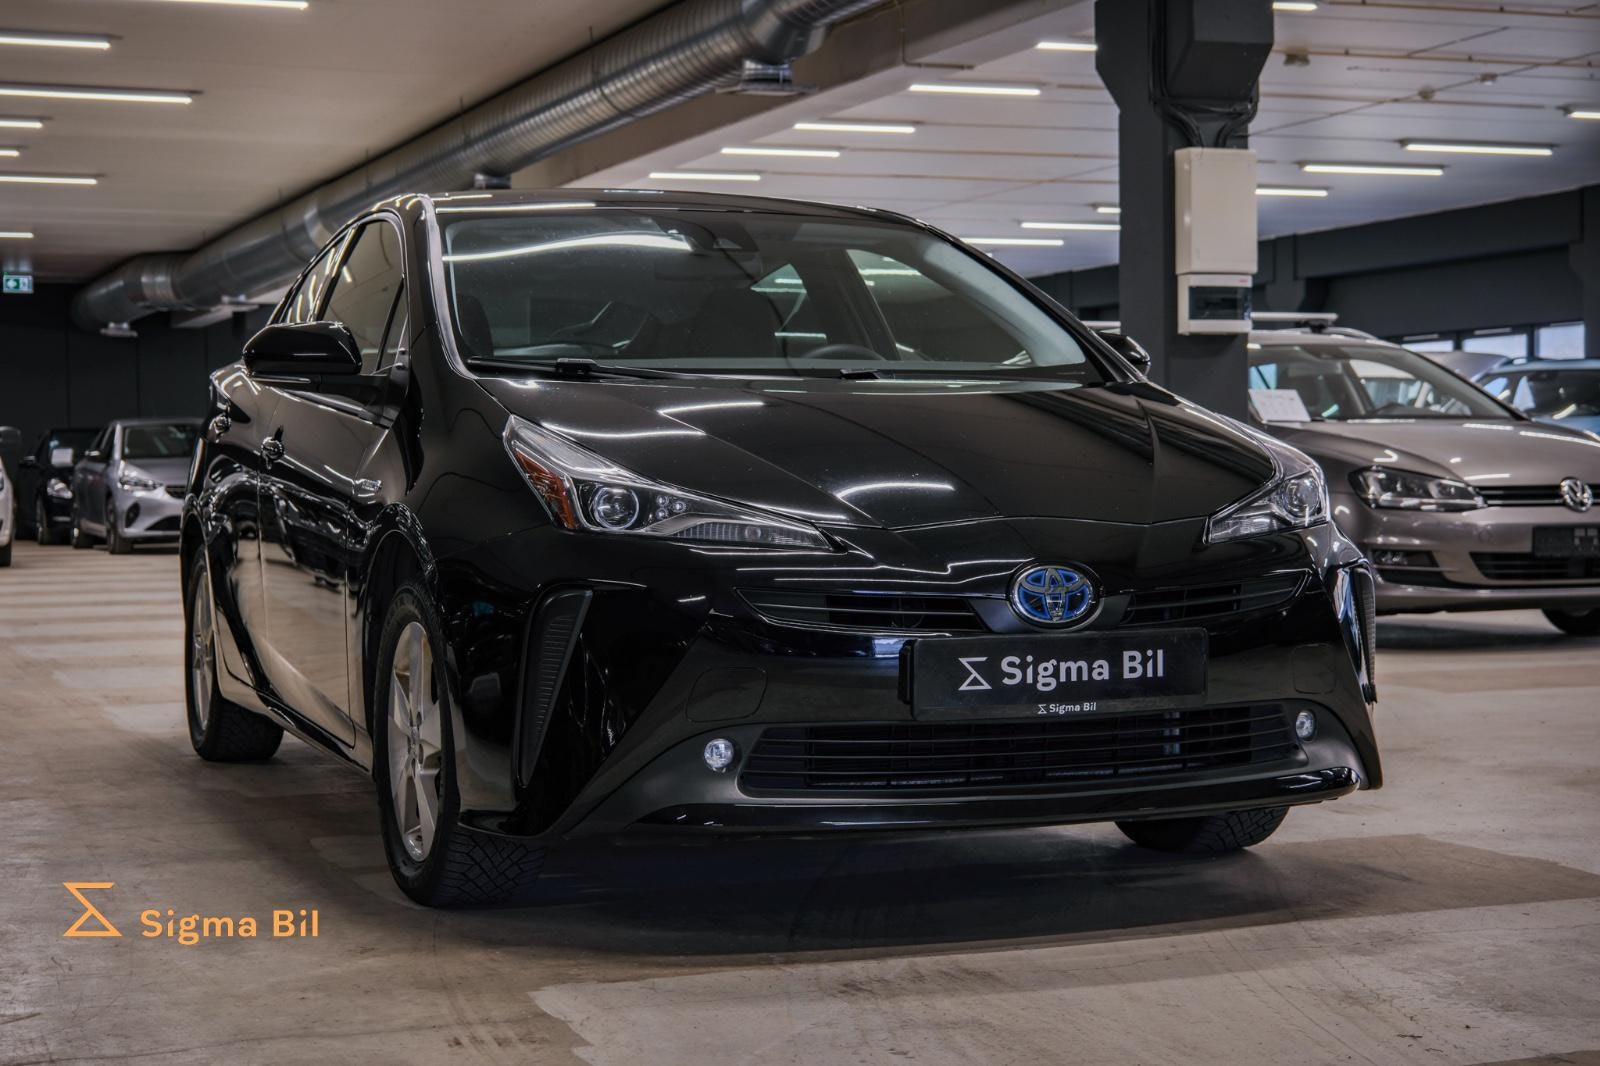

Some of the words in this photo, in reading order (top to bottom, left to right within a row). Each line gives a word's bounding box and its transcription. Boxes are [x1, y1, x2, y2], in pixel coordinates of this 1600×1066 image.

[1000, 655, 1110, 692] Sigma
[1122, 649, 1164, 679] Bil
[1049, 703, 1081, 715] Sigma
[1083, 702, 1097, 711] Bil
